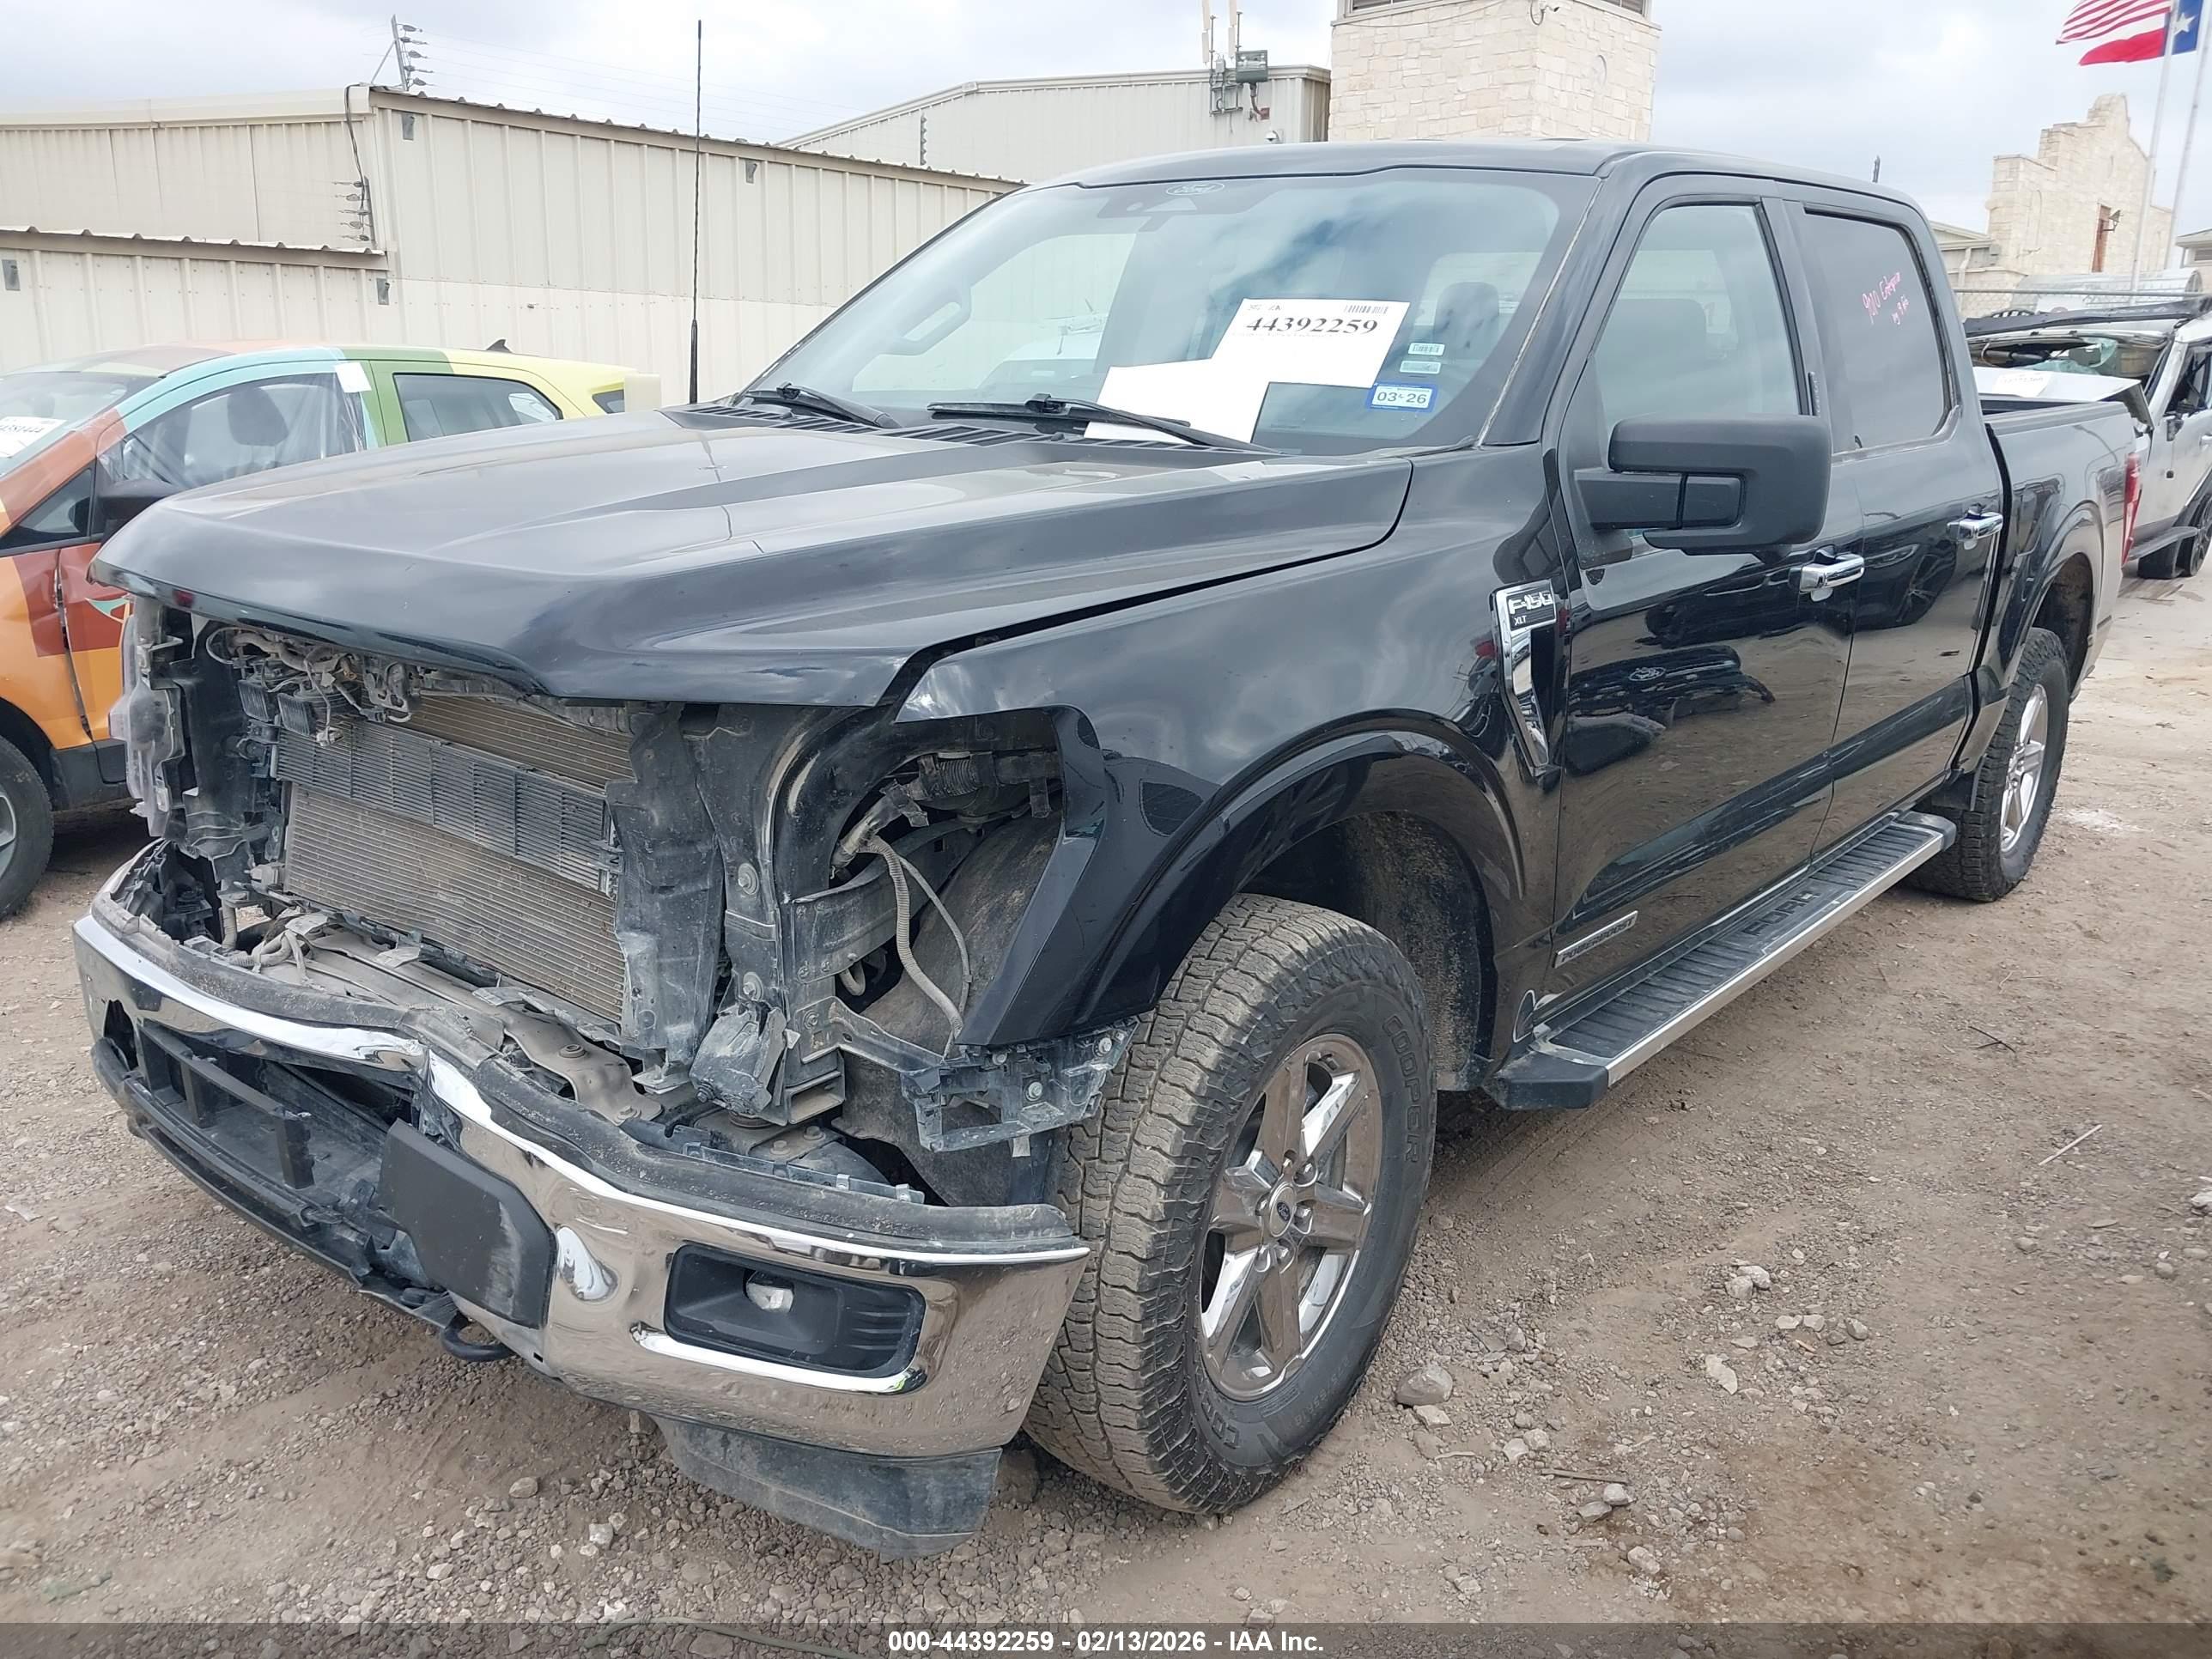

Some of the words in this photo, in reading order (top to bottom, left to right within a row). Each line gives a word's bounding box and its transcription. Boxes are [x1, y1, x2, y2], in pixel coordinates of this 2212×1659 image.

[1246, 317, 1378, 335] 44392259
[1377, 392, 1398, 402] 03
[1406, 393, 1427, 404] 26
[1509, 591, 1553, 614] F-150
[1514, 616, 1527, 626] XLT
[1382, 1014, 1422, 1163] COOPER
